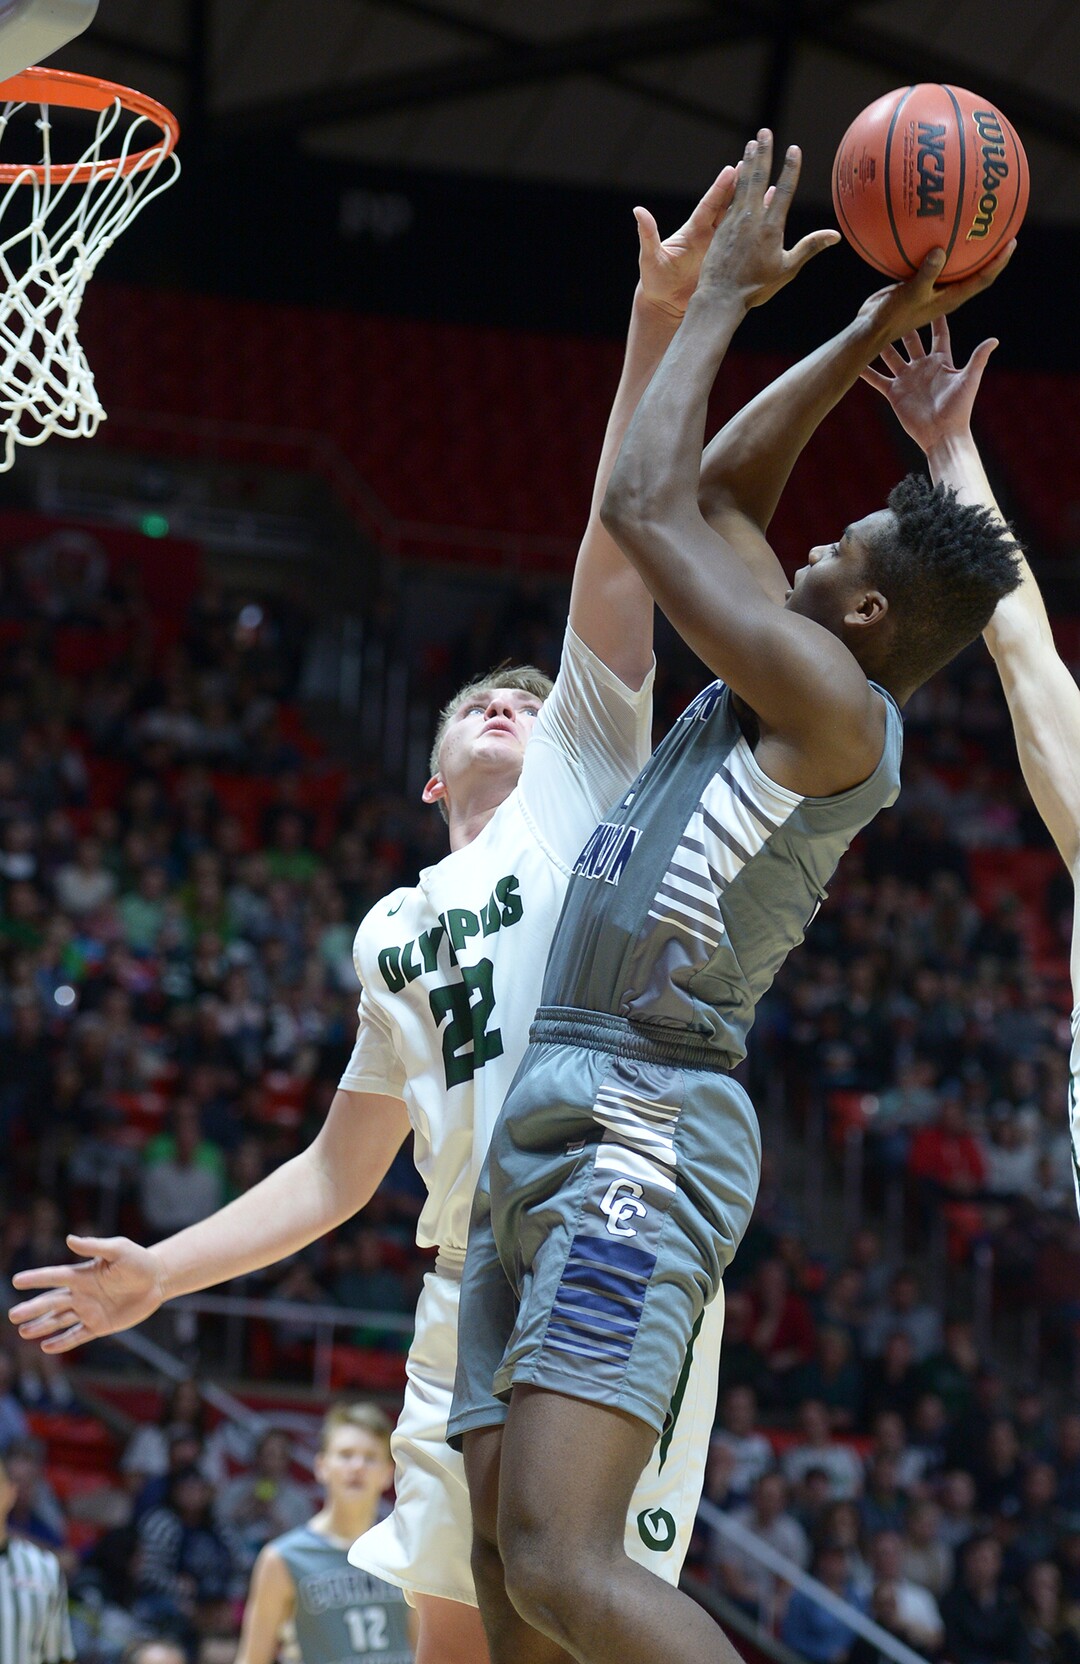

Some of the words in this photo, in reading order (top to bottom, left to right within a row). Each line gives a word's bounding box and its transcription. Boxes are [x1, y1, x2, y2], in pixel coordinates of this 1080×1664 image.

[916, 121, 946, 218] NCAA
[966, 110, 1009, 241] Wilson
[429, 957, 504, 1092] 22
[343, 1605, 389, 1652] 12
